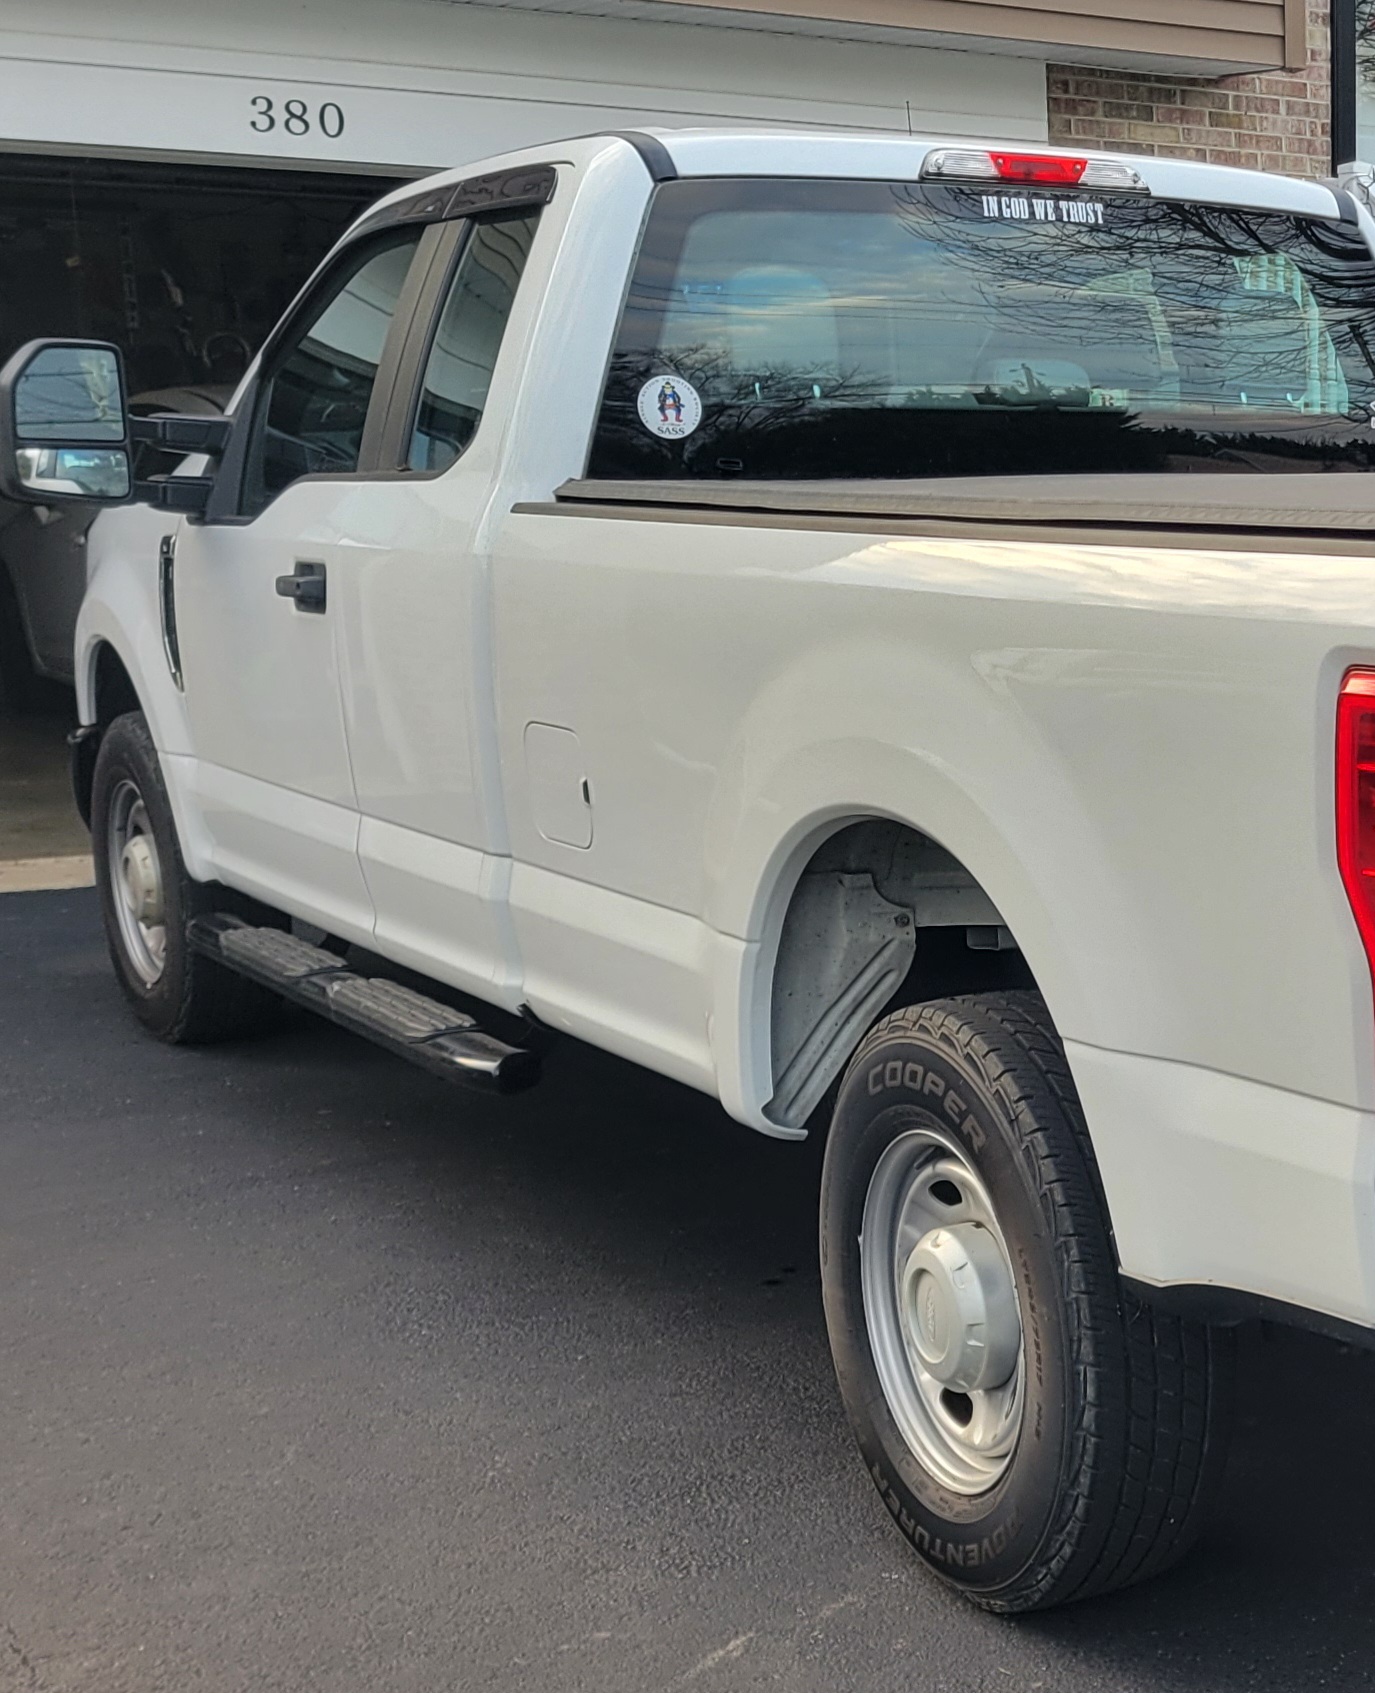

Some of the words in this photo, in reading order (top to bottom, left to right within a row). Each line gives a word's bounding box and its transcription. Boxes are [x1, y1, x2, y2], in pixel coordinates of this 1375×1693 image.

[250, 95, 345, 138] 380
[981, 195, 999, 218] IN
[1001, 198, 1030, 220] GOD
[1032, 199, 1057, 222] WE
[1059, 201, 1104, 225] TRUST
[657, 426, 685, 436] SASS
[867, 1060, 987, 1154] COOPER
